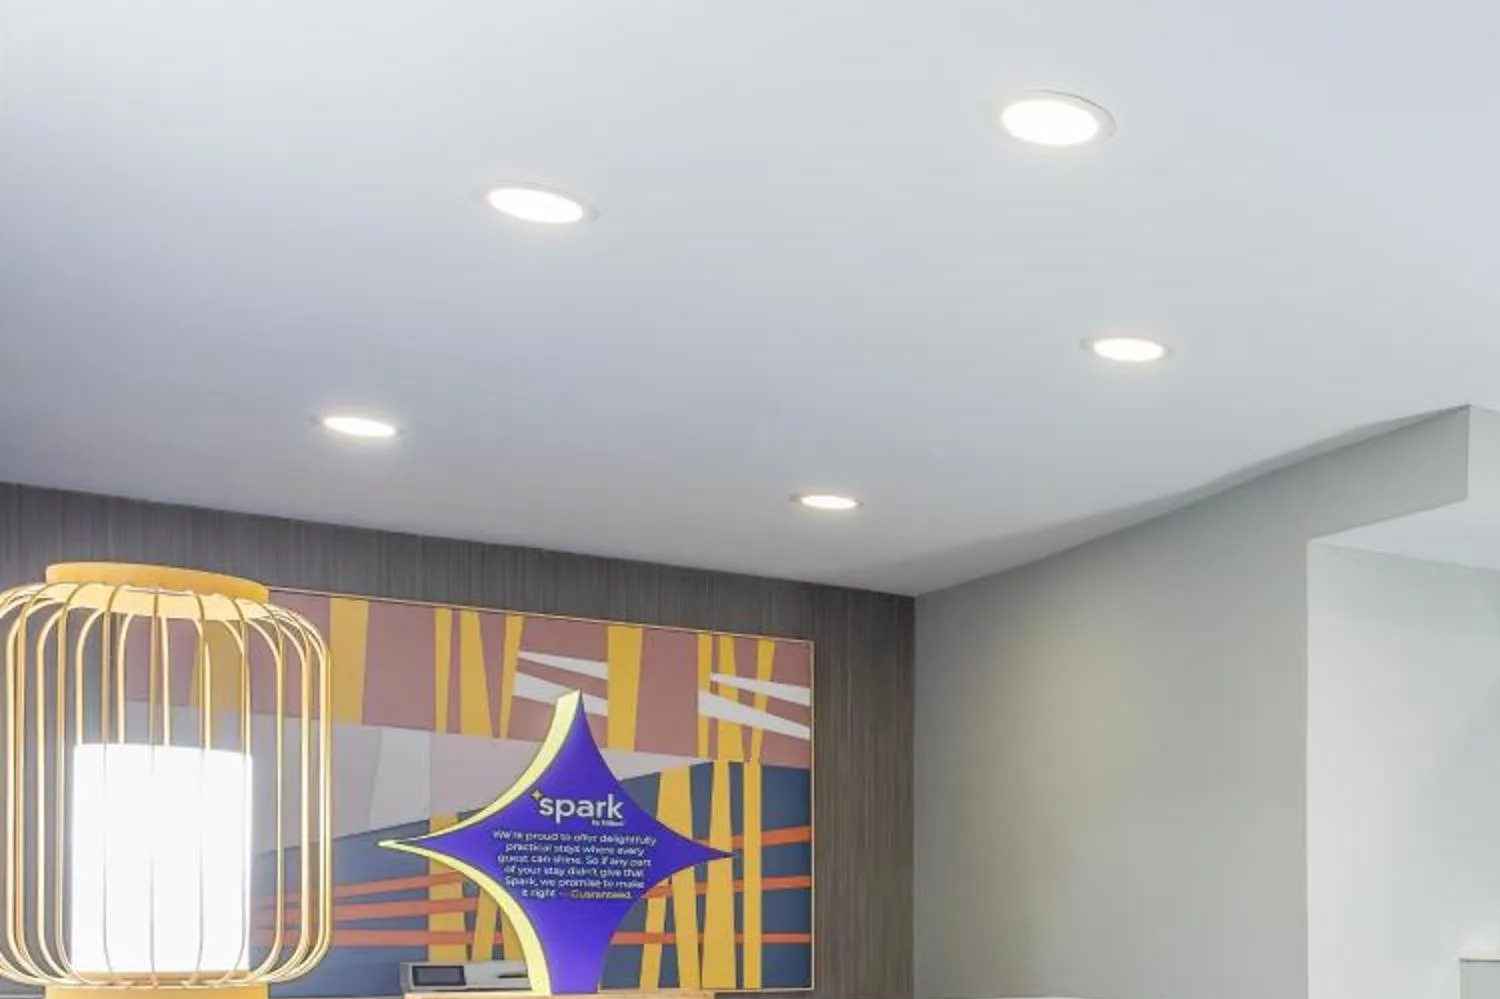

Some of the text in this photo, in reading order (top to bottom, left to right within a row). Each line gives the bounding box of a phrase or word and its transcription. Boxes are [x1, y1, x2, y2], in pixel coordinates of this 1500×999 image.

[539, 793, 624, 825] spark
[493, 829, 523, 840] We're
[525, 832, 559, 843] proud
[560, 832, 571, 842] to
[600, 834, 657, 847] delightfully
[505, 842, 551, 853] practical
[617, 847, 645, 857] every
[497, 854, 529, 865] guest
[531, 855, 551, 863] can
[585, 857, 599, 866] So
[610, 858, 628, 868] any
[504, 866, 516, 874] of
[517, 867, 542, 878] your
[543, 867, 566, 878] stay
[600, 868, 622, 879] give
[505, 877, 645, 891] Spark, we promise to make
[530, 889, 555, 900] right
